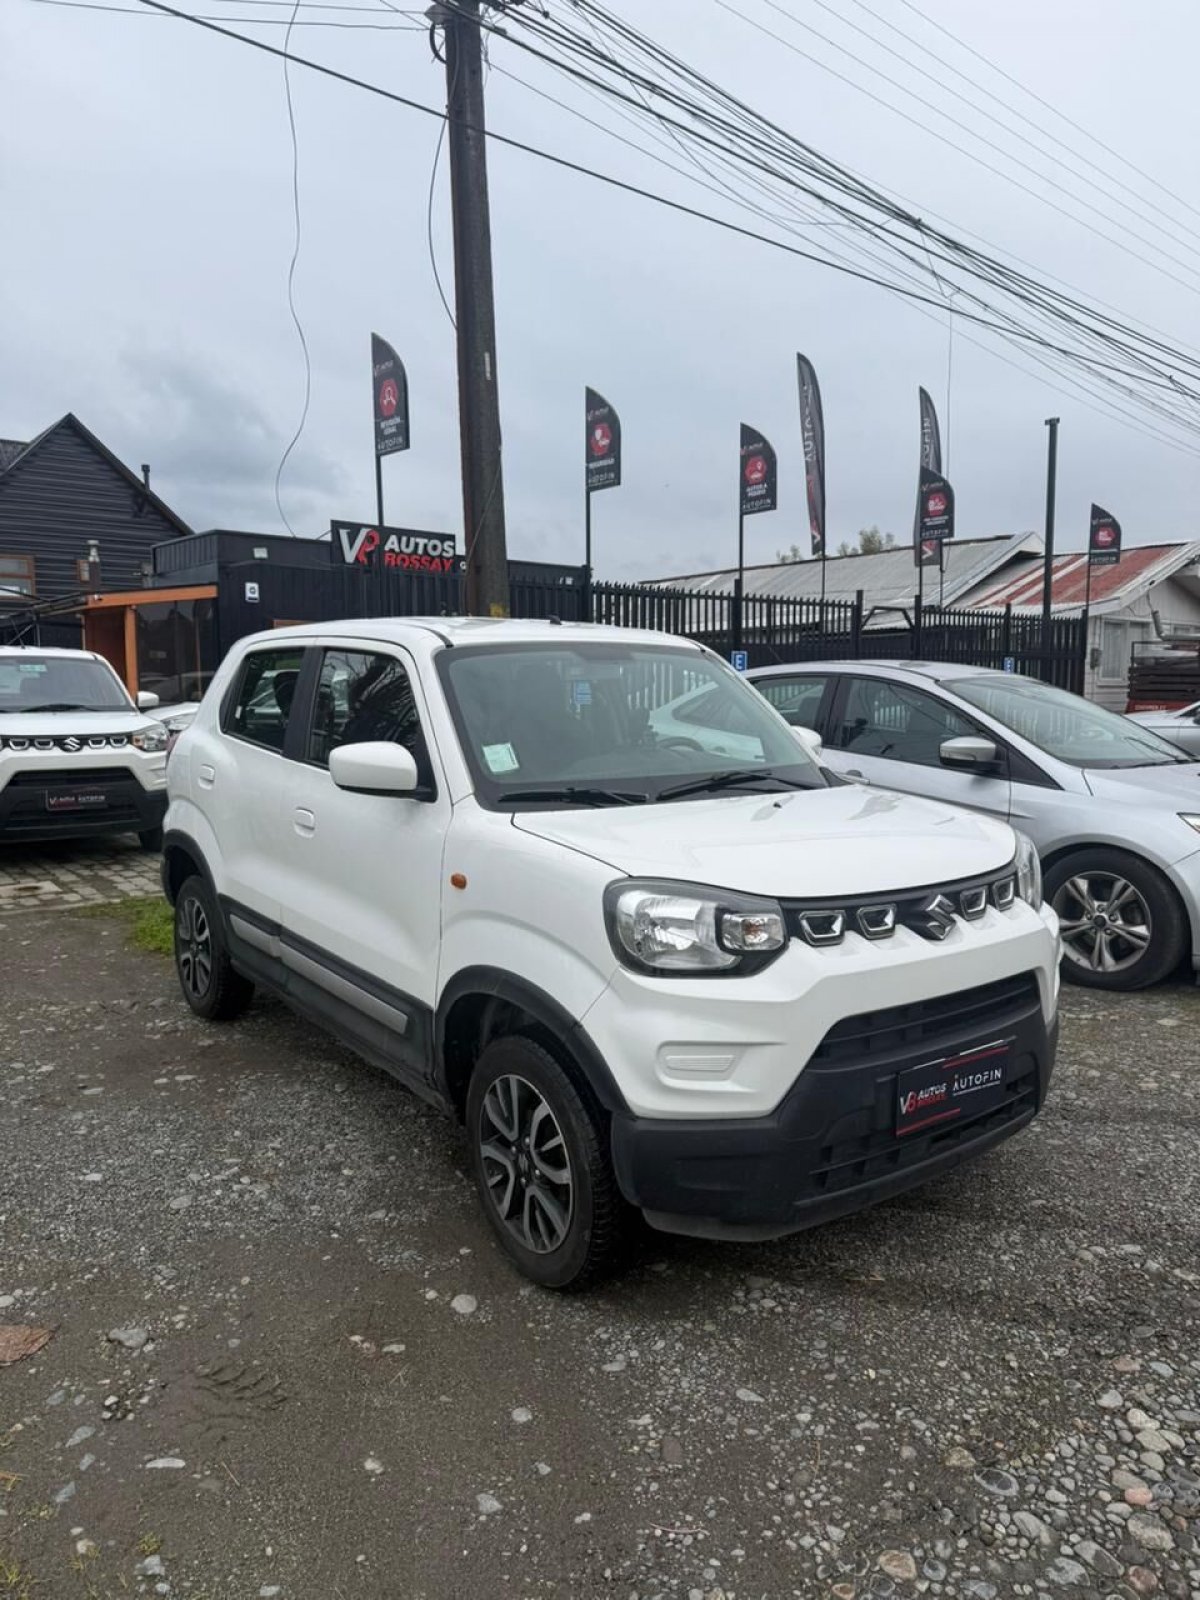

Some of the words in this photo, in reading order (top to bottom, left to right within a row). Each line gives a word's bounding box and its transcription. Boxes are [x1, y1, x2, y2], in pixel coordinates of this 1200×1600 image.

[384, 534, 456, 558] AUTOS
[384, 551, 454, 573] ROSSAY
[735, 654, 744, 670] E
[918, 1083, 947, 1101] AUTOS
[952, 1067, 1002, 1092] AUTOFIN
